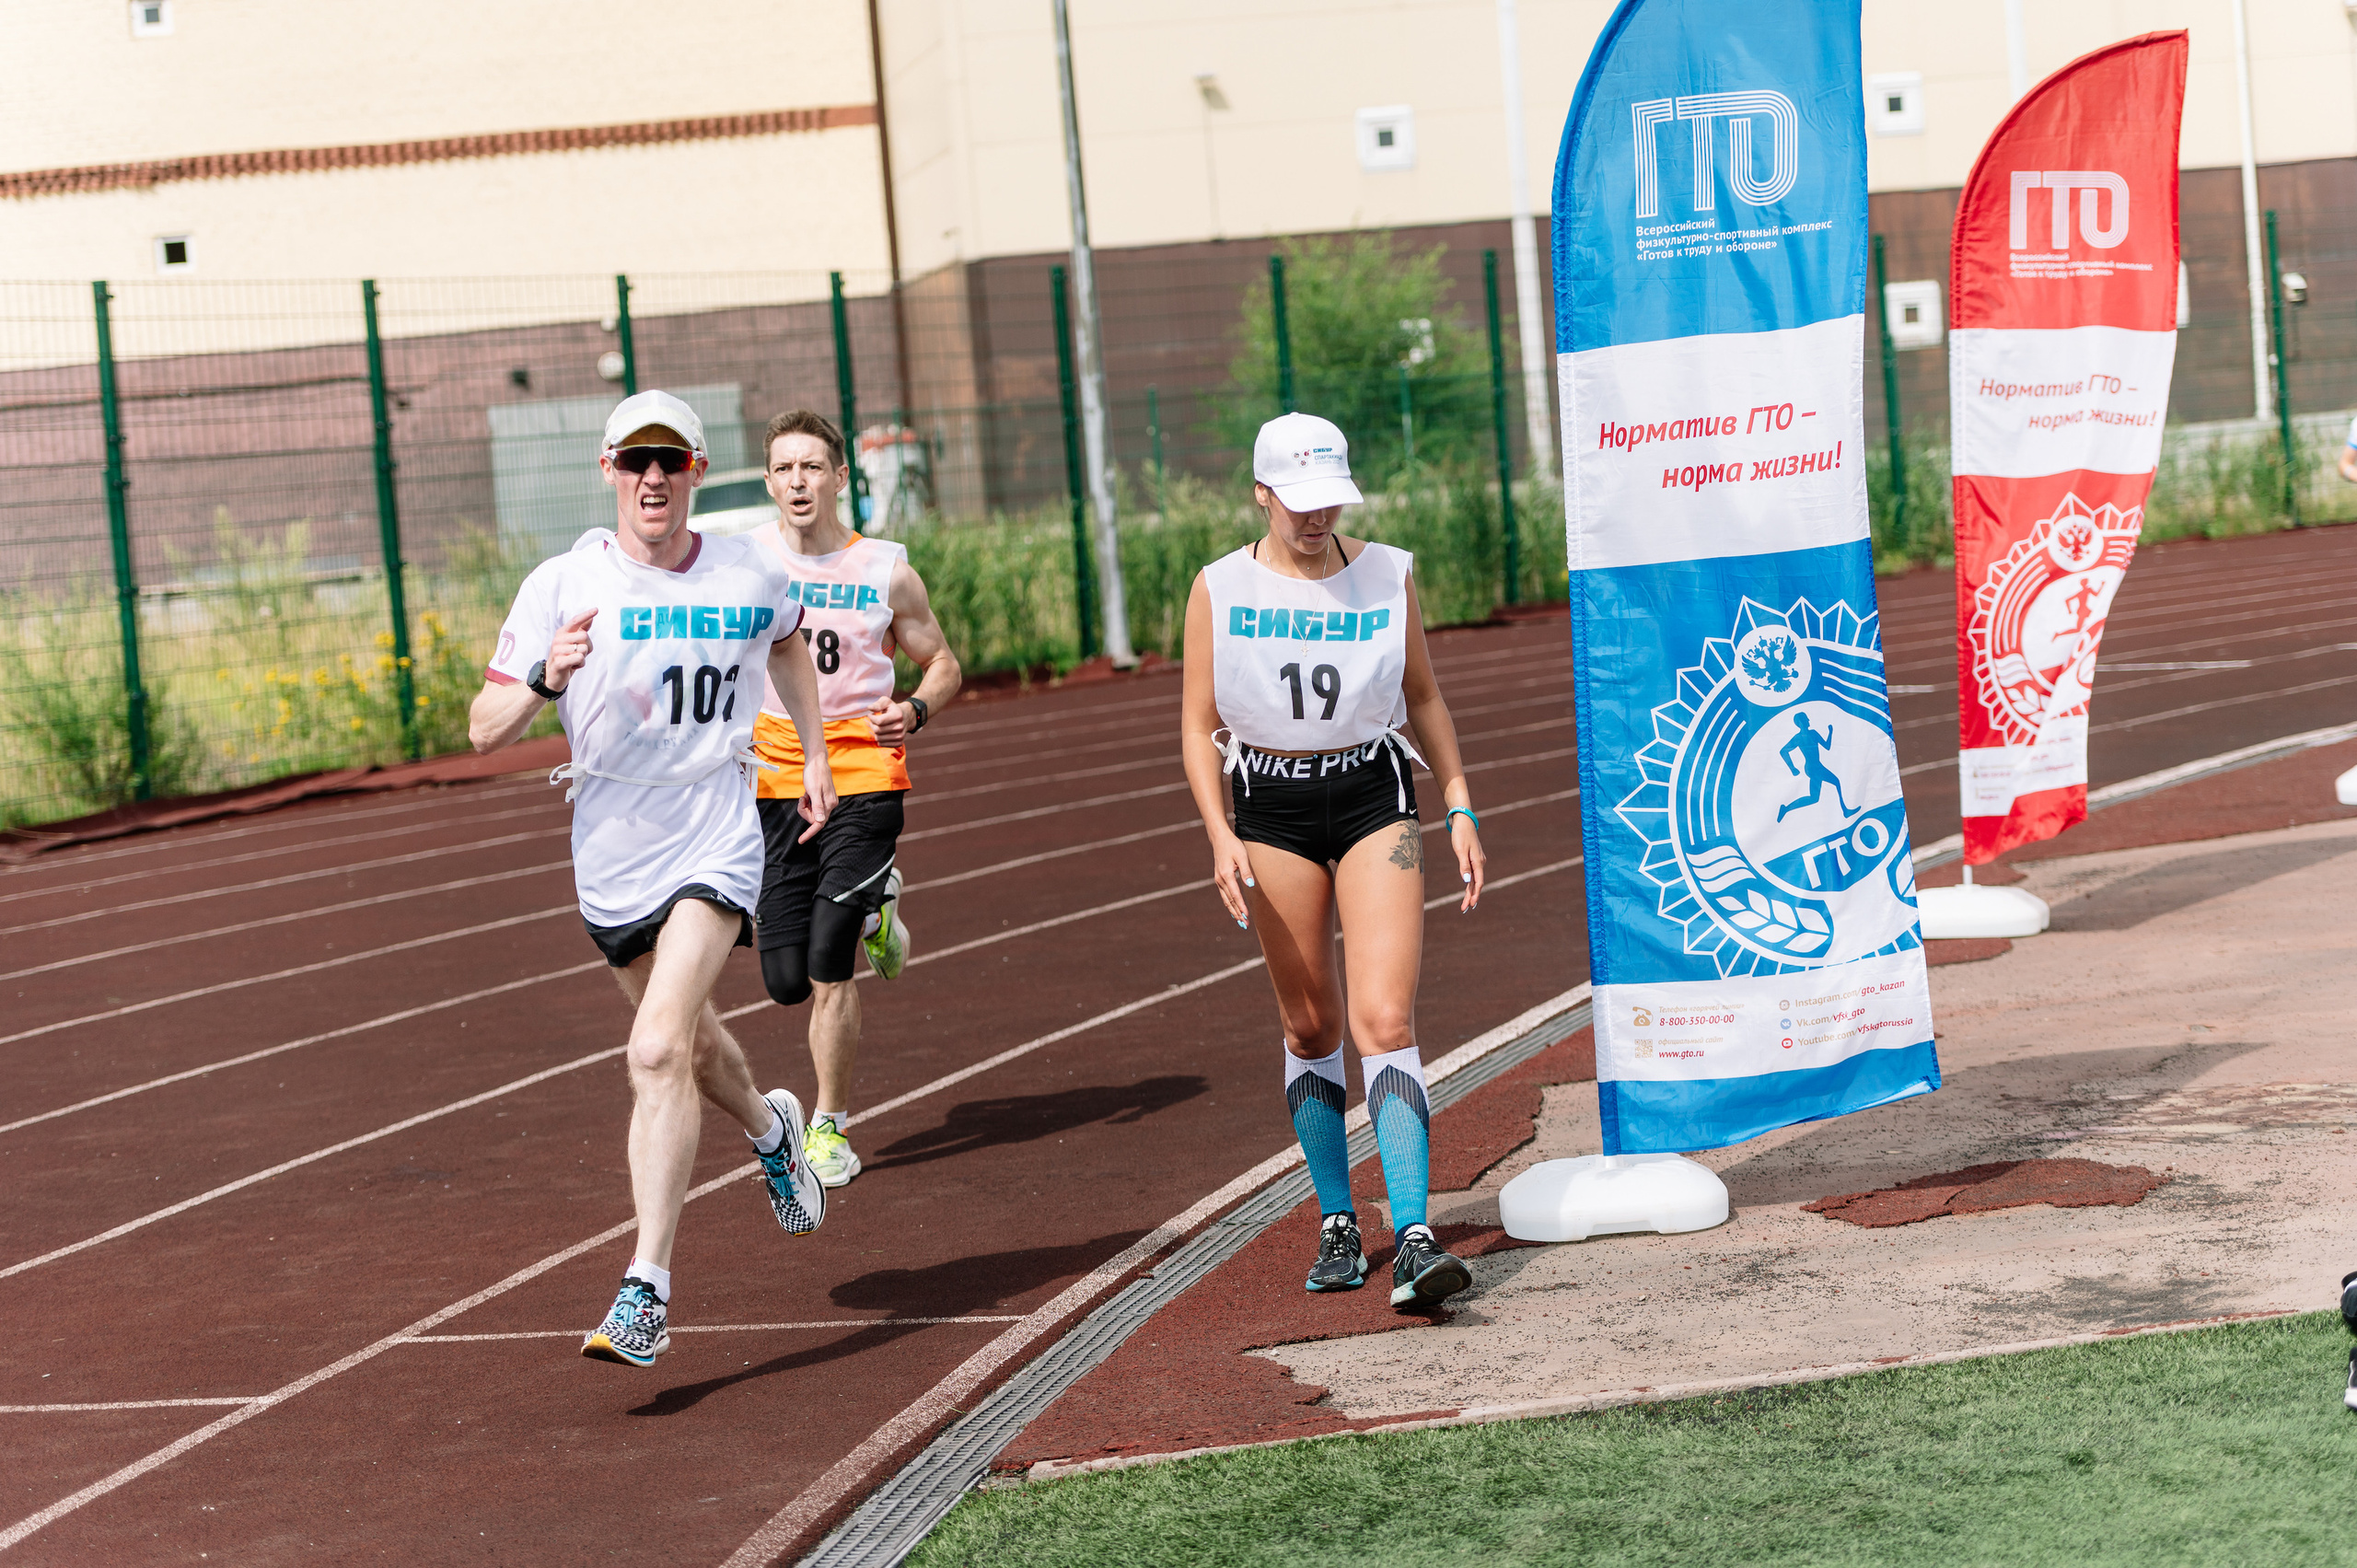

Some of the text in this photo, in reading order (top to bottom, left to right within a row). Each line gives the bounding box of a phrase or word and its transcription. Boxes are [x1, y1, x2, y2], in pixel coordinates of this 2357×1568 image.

[1631, 89, 1798, 218] ГТО
[2009, 170, 2131, 250] ГТО
[1636, 218, 1715, 237] Всероссийский
[1636, 220, 1832, 250] физкультурно-спортивный комплекс
[1636, 240, 1778, 261] «Готов к труду и обороне»
[1980, 378, 2084, 401] Норматив
[2087, 375, 2122, 394] ГТО
[1598, 415, 1737, 452] Норматив
[1746, 402, 1794, 434] ГТО
[2028, 409, 2157, 432] норма жизни!
[1662, 440, 1842, 493] норма жизни!
[620, 605, 774, 640] СИБУР
[1229, 606, 1390, 642] СИБУР
[1280, 663, 1341, 720] 19
[1245, 740, 1378, 779] NIKE PRO
[1802, 818, 1889, 889] ГТО
[1795, 981, 1905, 1007] Instagram.com/gto_kazan
[1659, 1005, 1688, 1014] Телефон
[1659, 1014, 1735, 1027] 8-800-350-00-00
[1796, 1007, 1865, 1028] Vk.com/vfsk_gto
[1658, 1036, 1724, 1046] официальный сайт
[1798, 1017, 1913, 1047] Youtube.com/vfskgtorussia
[1658, 1051, 1704, 1060] www.gto.ru
